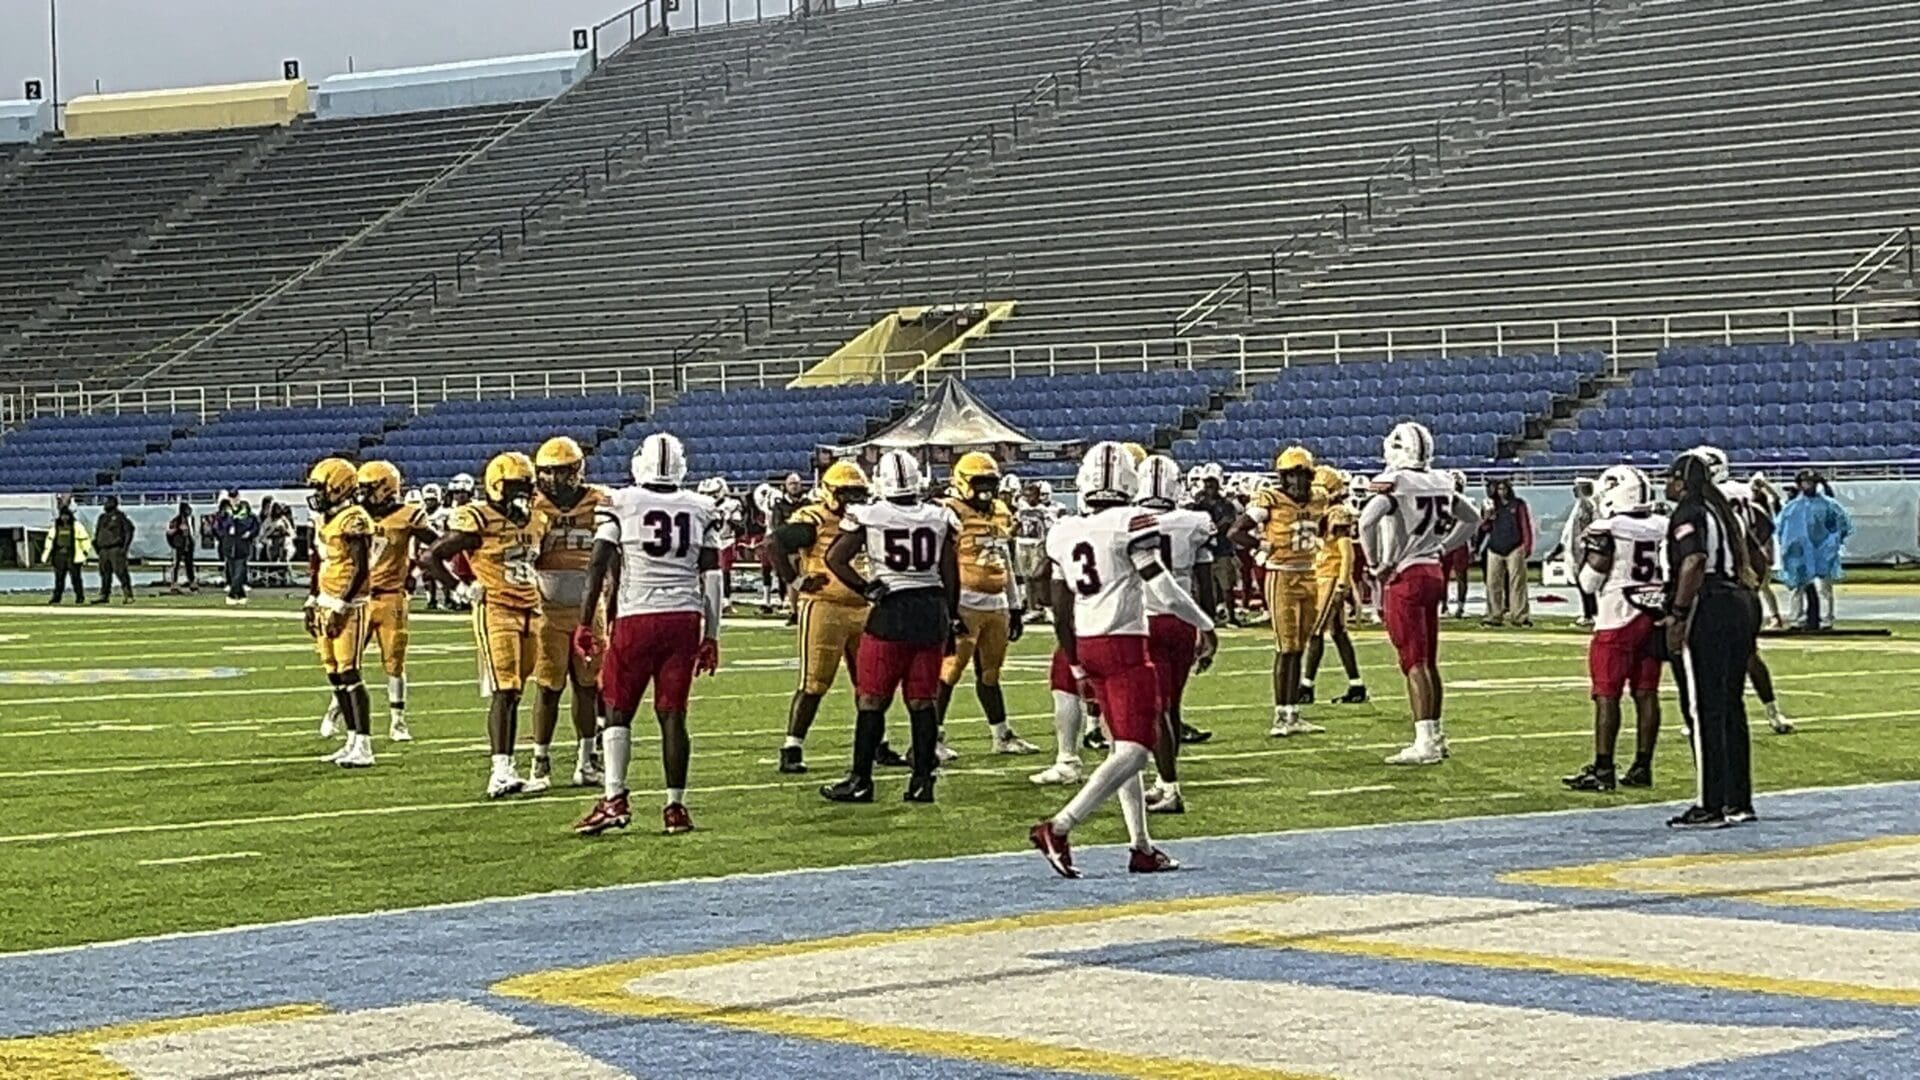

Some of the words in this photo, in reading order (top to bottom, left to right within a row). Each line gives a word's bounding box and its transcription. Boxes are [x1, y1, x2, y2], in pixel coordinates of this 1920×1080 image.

[29, 84, 38, 97] 2
[287, 63, 296, 77] 3
[643, 510, 690, 557] 31
[884, 527, 936, 572] 50
[1072, 541, 1101, 596] 3
[1632, 540, 1663, 583] 5
